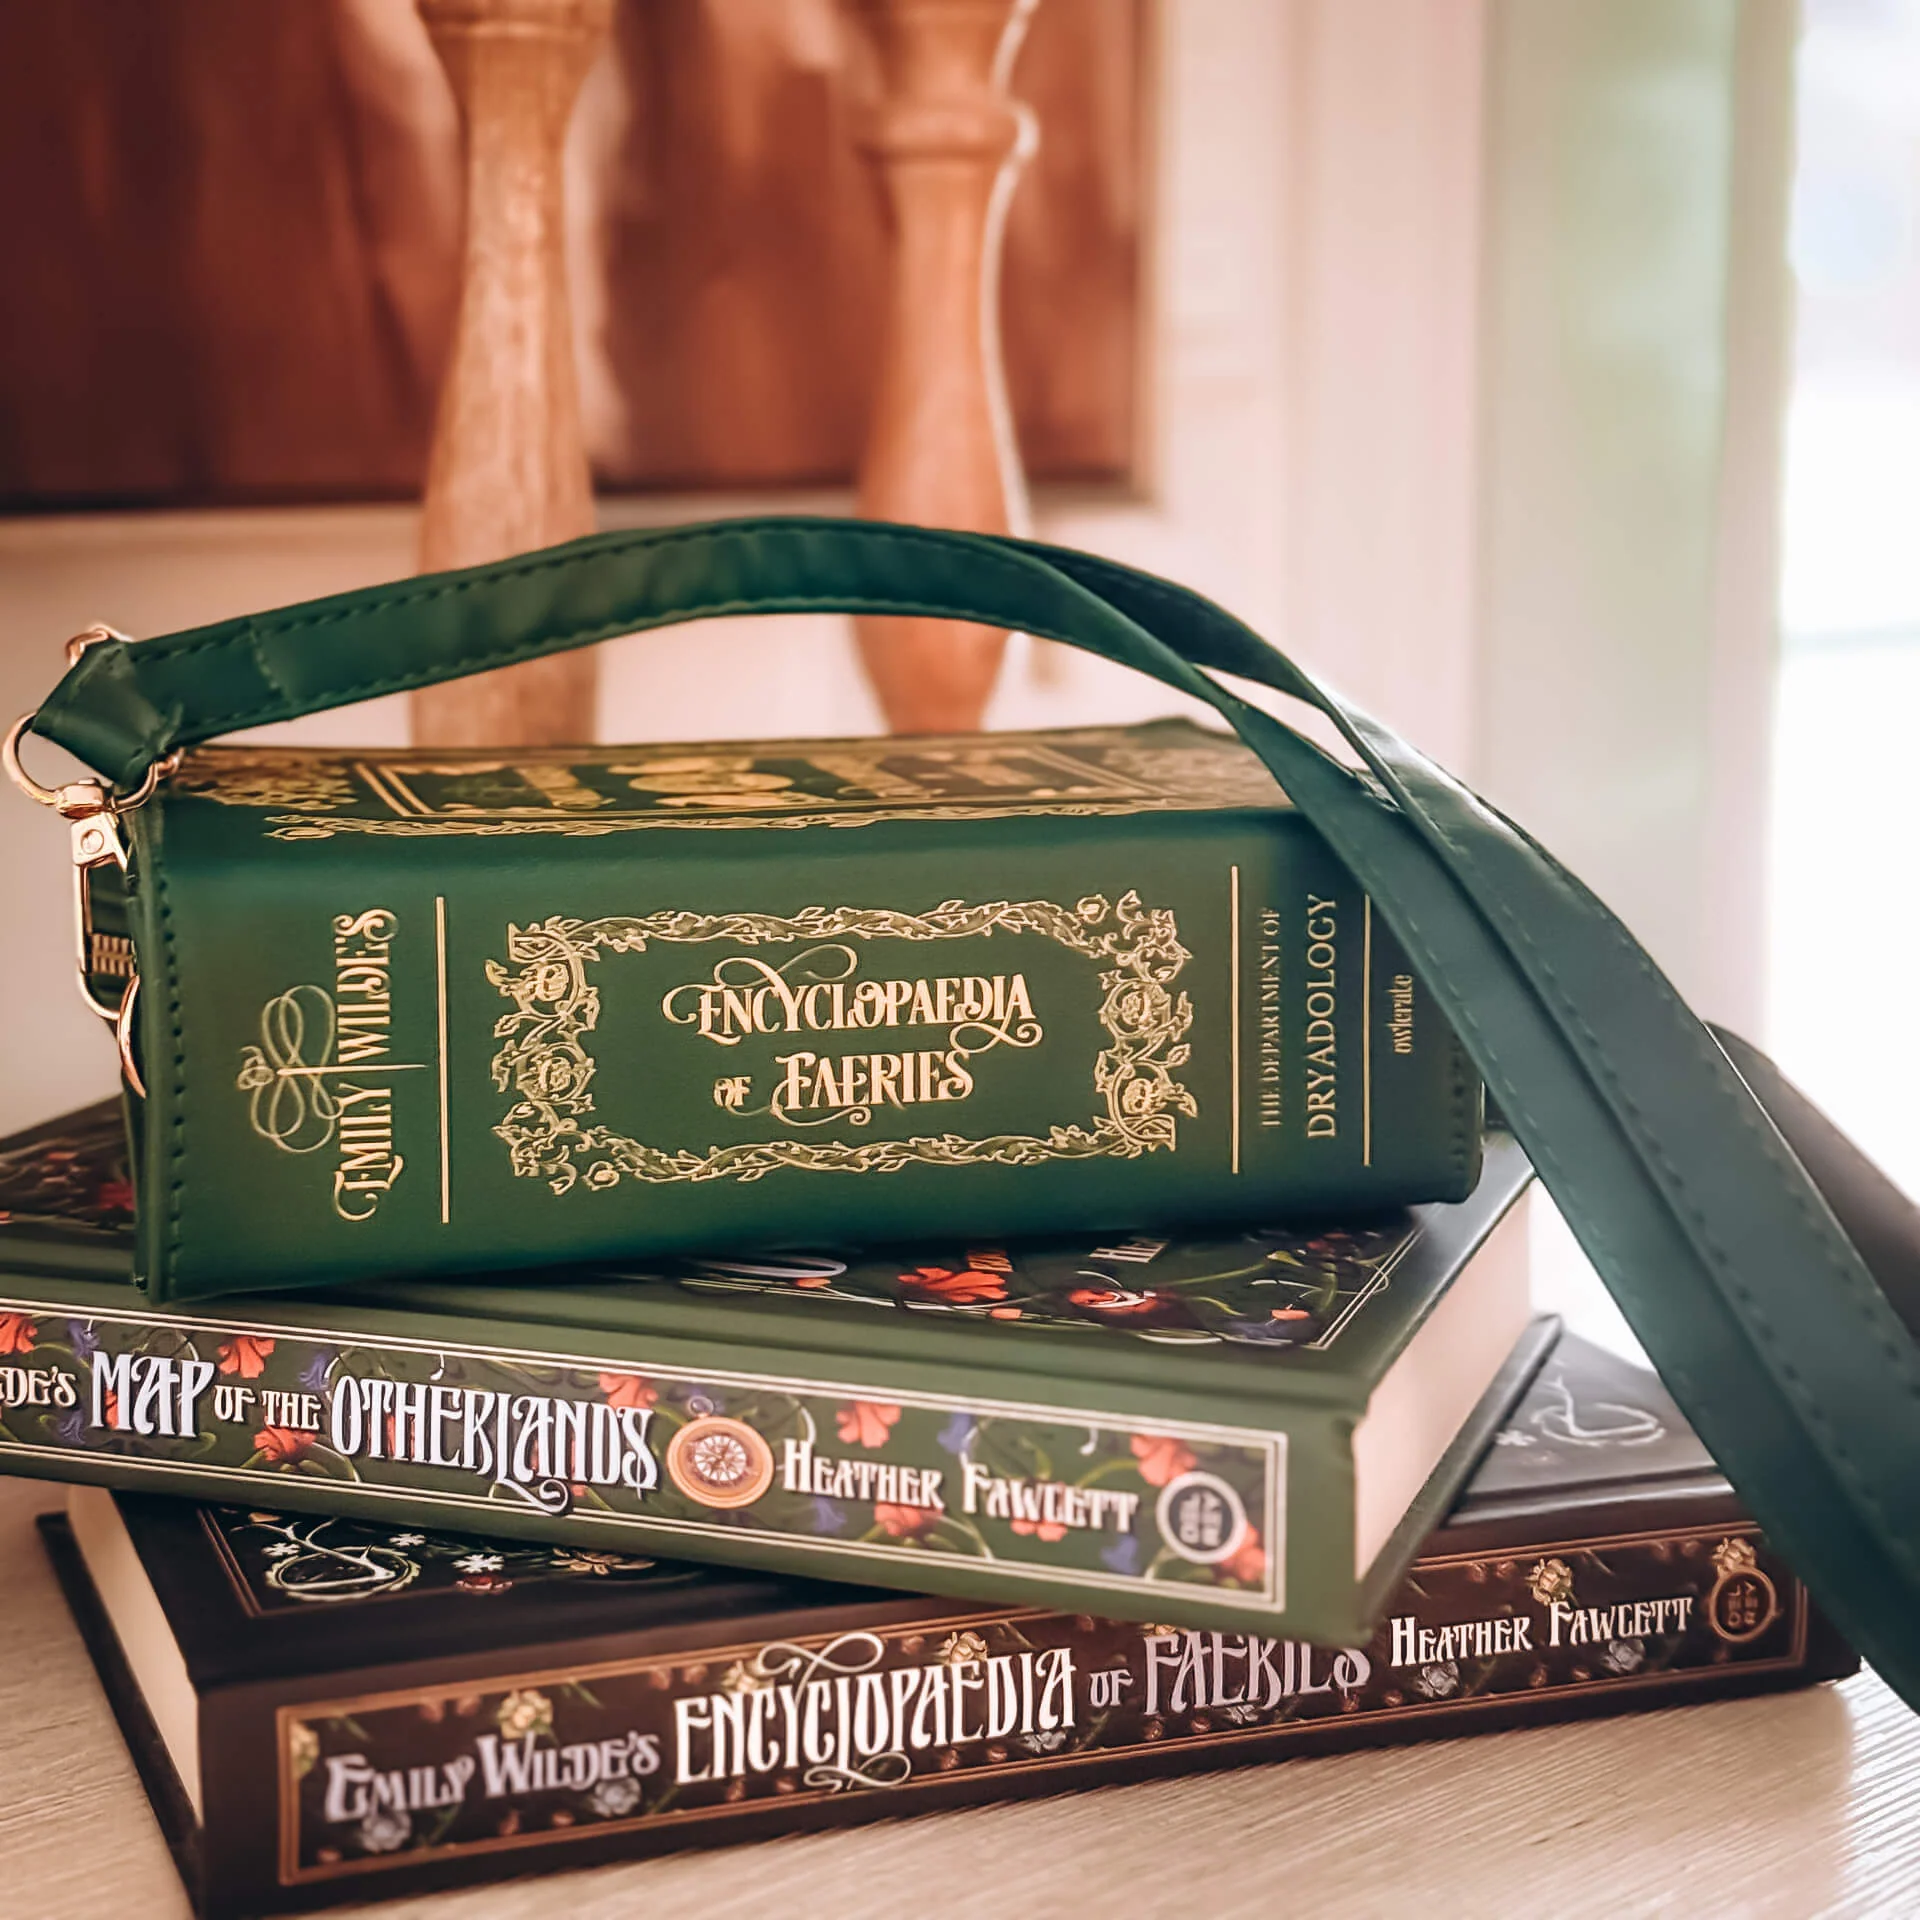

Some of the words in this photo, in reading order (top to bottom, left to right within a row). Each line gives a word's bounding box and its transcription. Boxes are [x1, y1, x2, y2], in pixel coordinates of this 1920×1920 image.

[1259, 906, 1280, 936] OF
[662, 944, 1043, 1052] ENCYCLOPAEDIA
[1307, 894, 1336, 1138] DRYADOLOGY
[771, 1048, 974, 1127] FAERIES
[333, 1082, 404, 1222] EMILY
[92, 1350, 214, 1438] MAP
[213, 1384, 256, 1423] OF
[262, 1390, 321, 1431] THE
[327, 1374, 657, 1514] OTHERLANDS
[781, 1436, 943, 1511] HEATHER
[963, 1463, 1139, 1534] FAWCETT
[1391, 1615, 1532, 1667] HEATHER
[1549, 1596, 1694, 1648] FAWCETT
[325, 1752, 474, 1822] EMILY
[475, 1730, 661, 1798] WILDE'S
[671, 1631, 1077, 1793] ENCYCLOPAEDIA
[1090, 1668, 1133, 1708] OF
